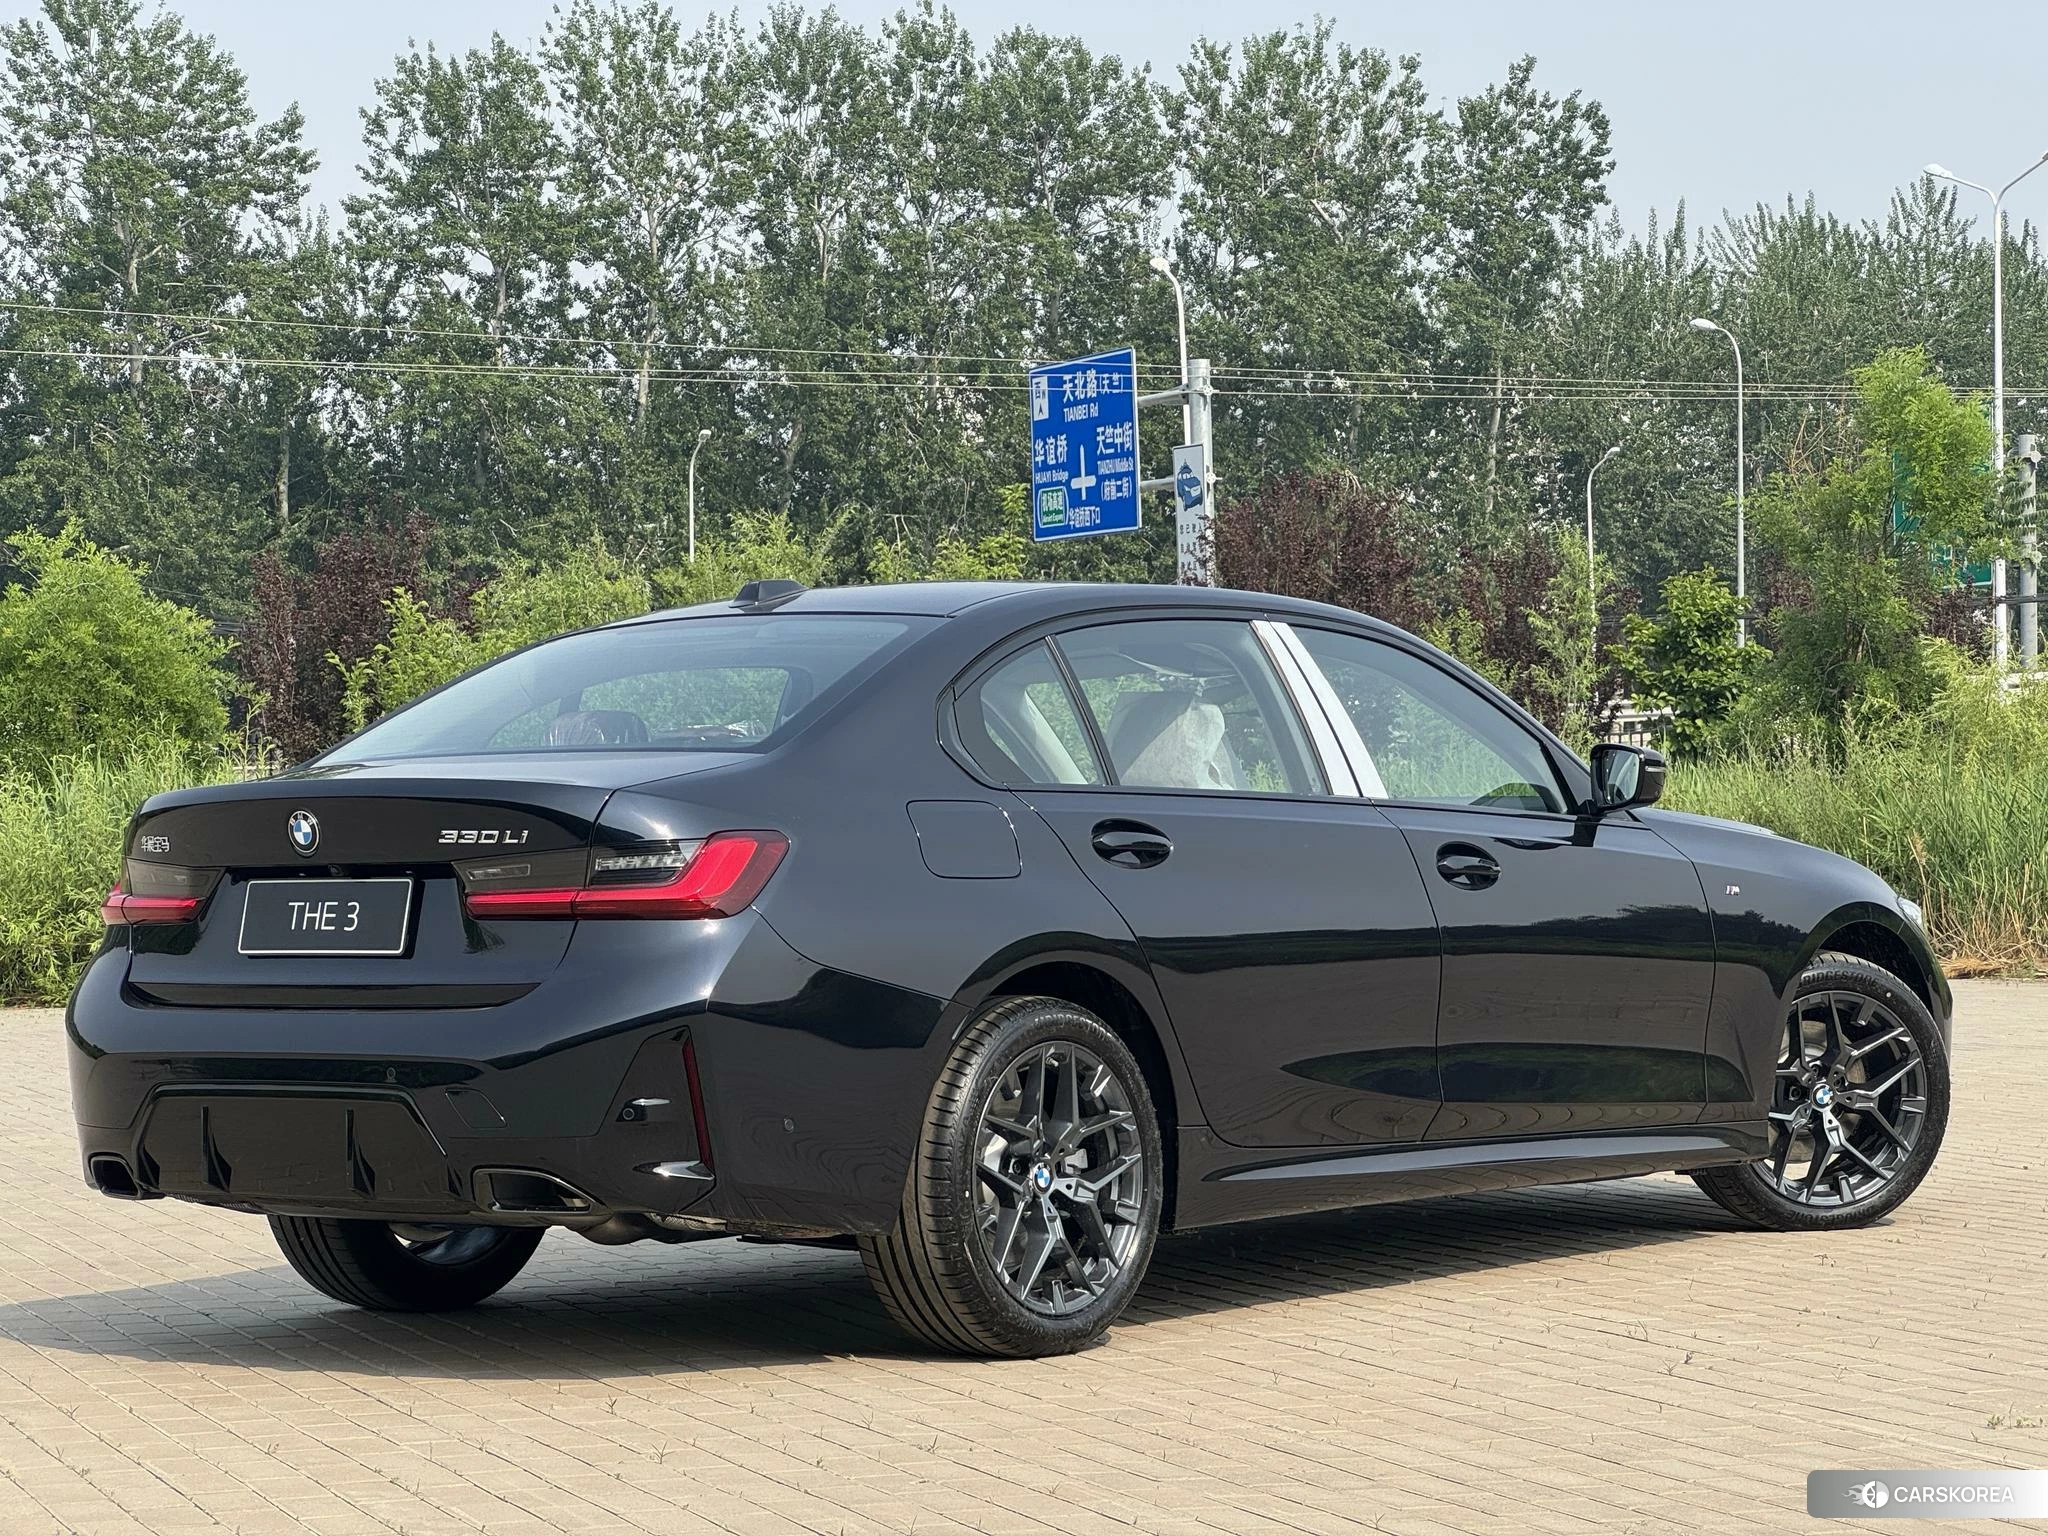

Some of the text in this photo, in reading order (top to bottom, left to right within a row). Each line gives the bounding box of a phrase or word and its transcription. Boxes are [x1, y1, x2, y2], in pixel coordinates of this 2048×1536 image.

[1063, 402, 1099, 423] TIANBEI Rd
[1096, 421, 1133, 456] 天竺中街
[1034, 433, 1068, 468] 华谊桥
[1035, 469, 1069, 484] HUAYI Bridge
[289, 812, 314, 826] BMW
[141, 835, 170, 853] 华晨宝马
[288, 901, 360, 931] THE 3
[1801, 970, 1879, 988] RIDGESTONE
